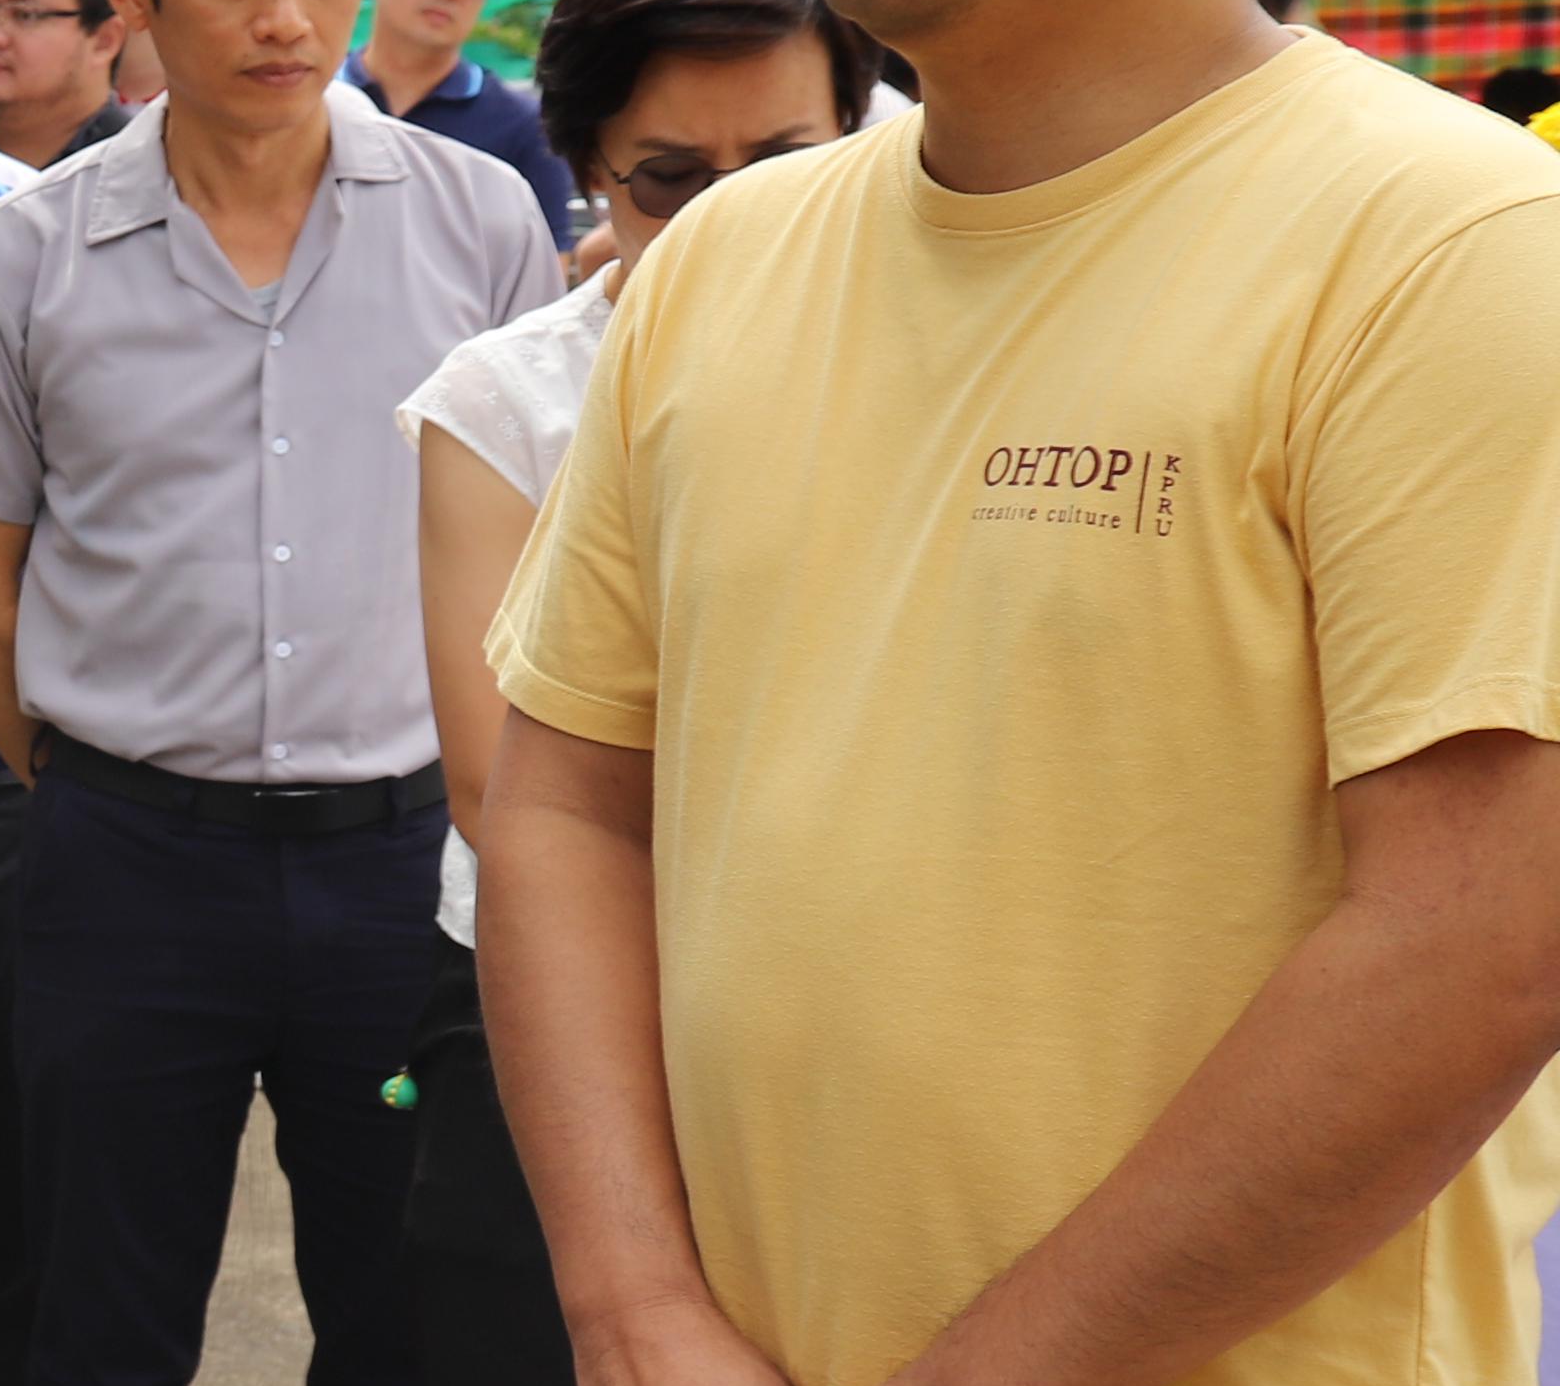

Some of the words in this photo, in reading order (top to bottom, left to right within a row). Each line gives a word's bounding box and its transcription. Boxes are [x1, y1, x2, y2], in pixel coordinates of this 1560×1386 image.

[983, 445, 1134, 491] OHTOP
[971, 502, 1038, 521] creative
[1046, 504, 1122, 529] culture
[1156, 454, 1182, 537] KPRU
